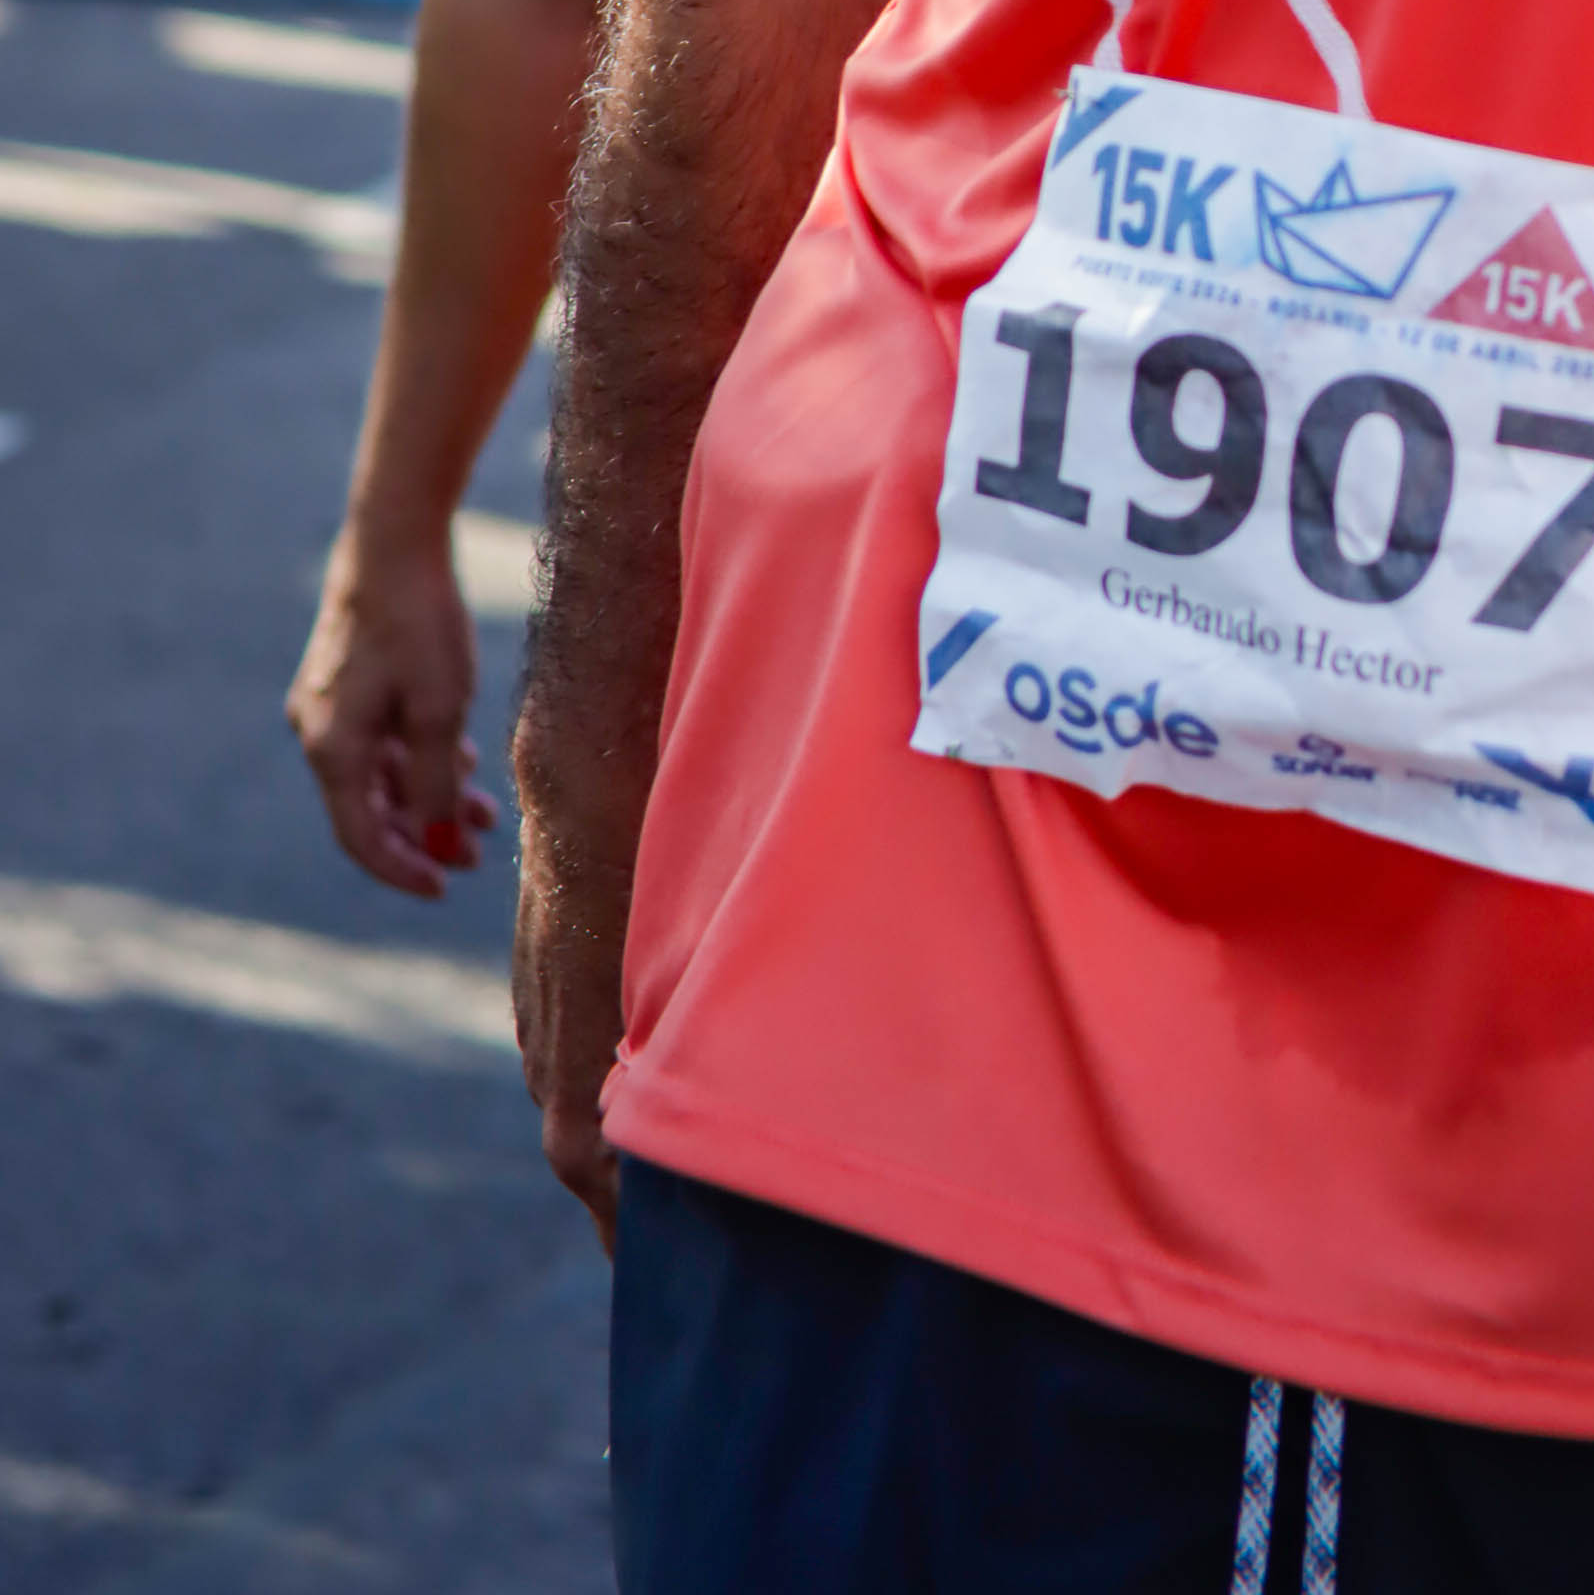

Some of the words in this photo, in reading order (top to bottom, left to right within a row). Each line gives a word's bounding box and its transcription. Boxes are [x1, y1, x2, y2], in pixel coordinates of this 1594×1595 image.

[1092, 143, 1238, 262] 15K
[1481, 261, 1588, 333] 15K
[1100, 566, 1282, 657] Gerbaudo
[1294, 624, 1445, 695] Hector
[1004, 661, 1220, 758] osde
